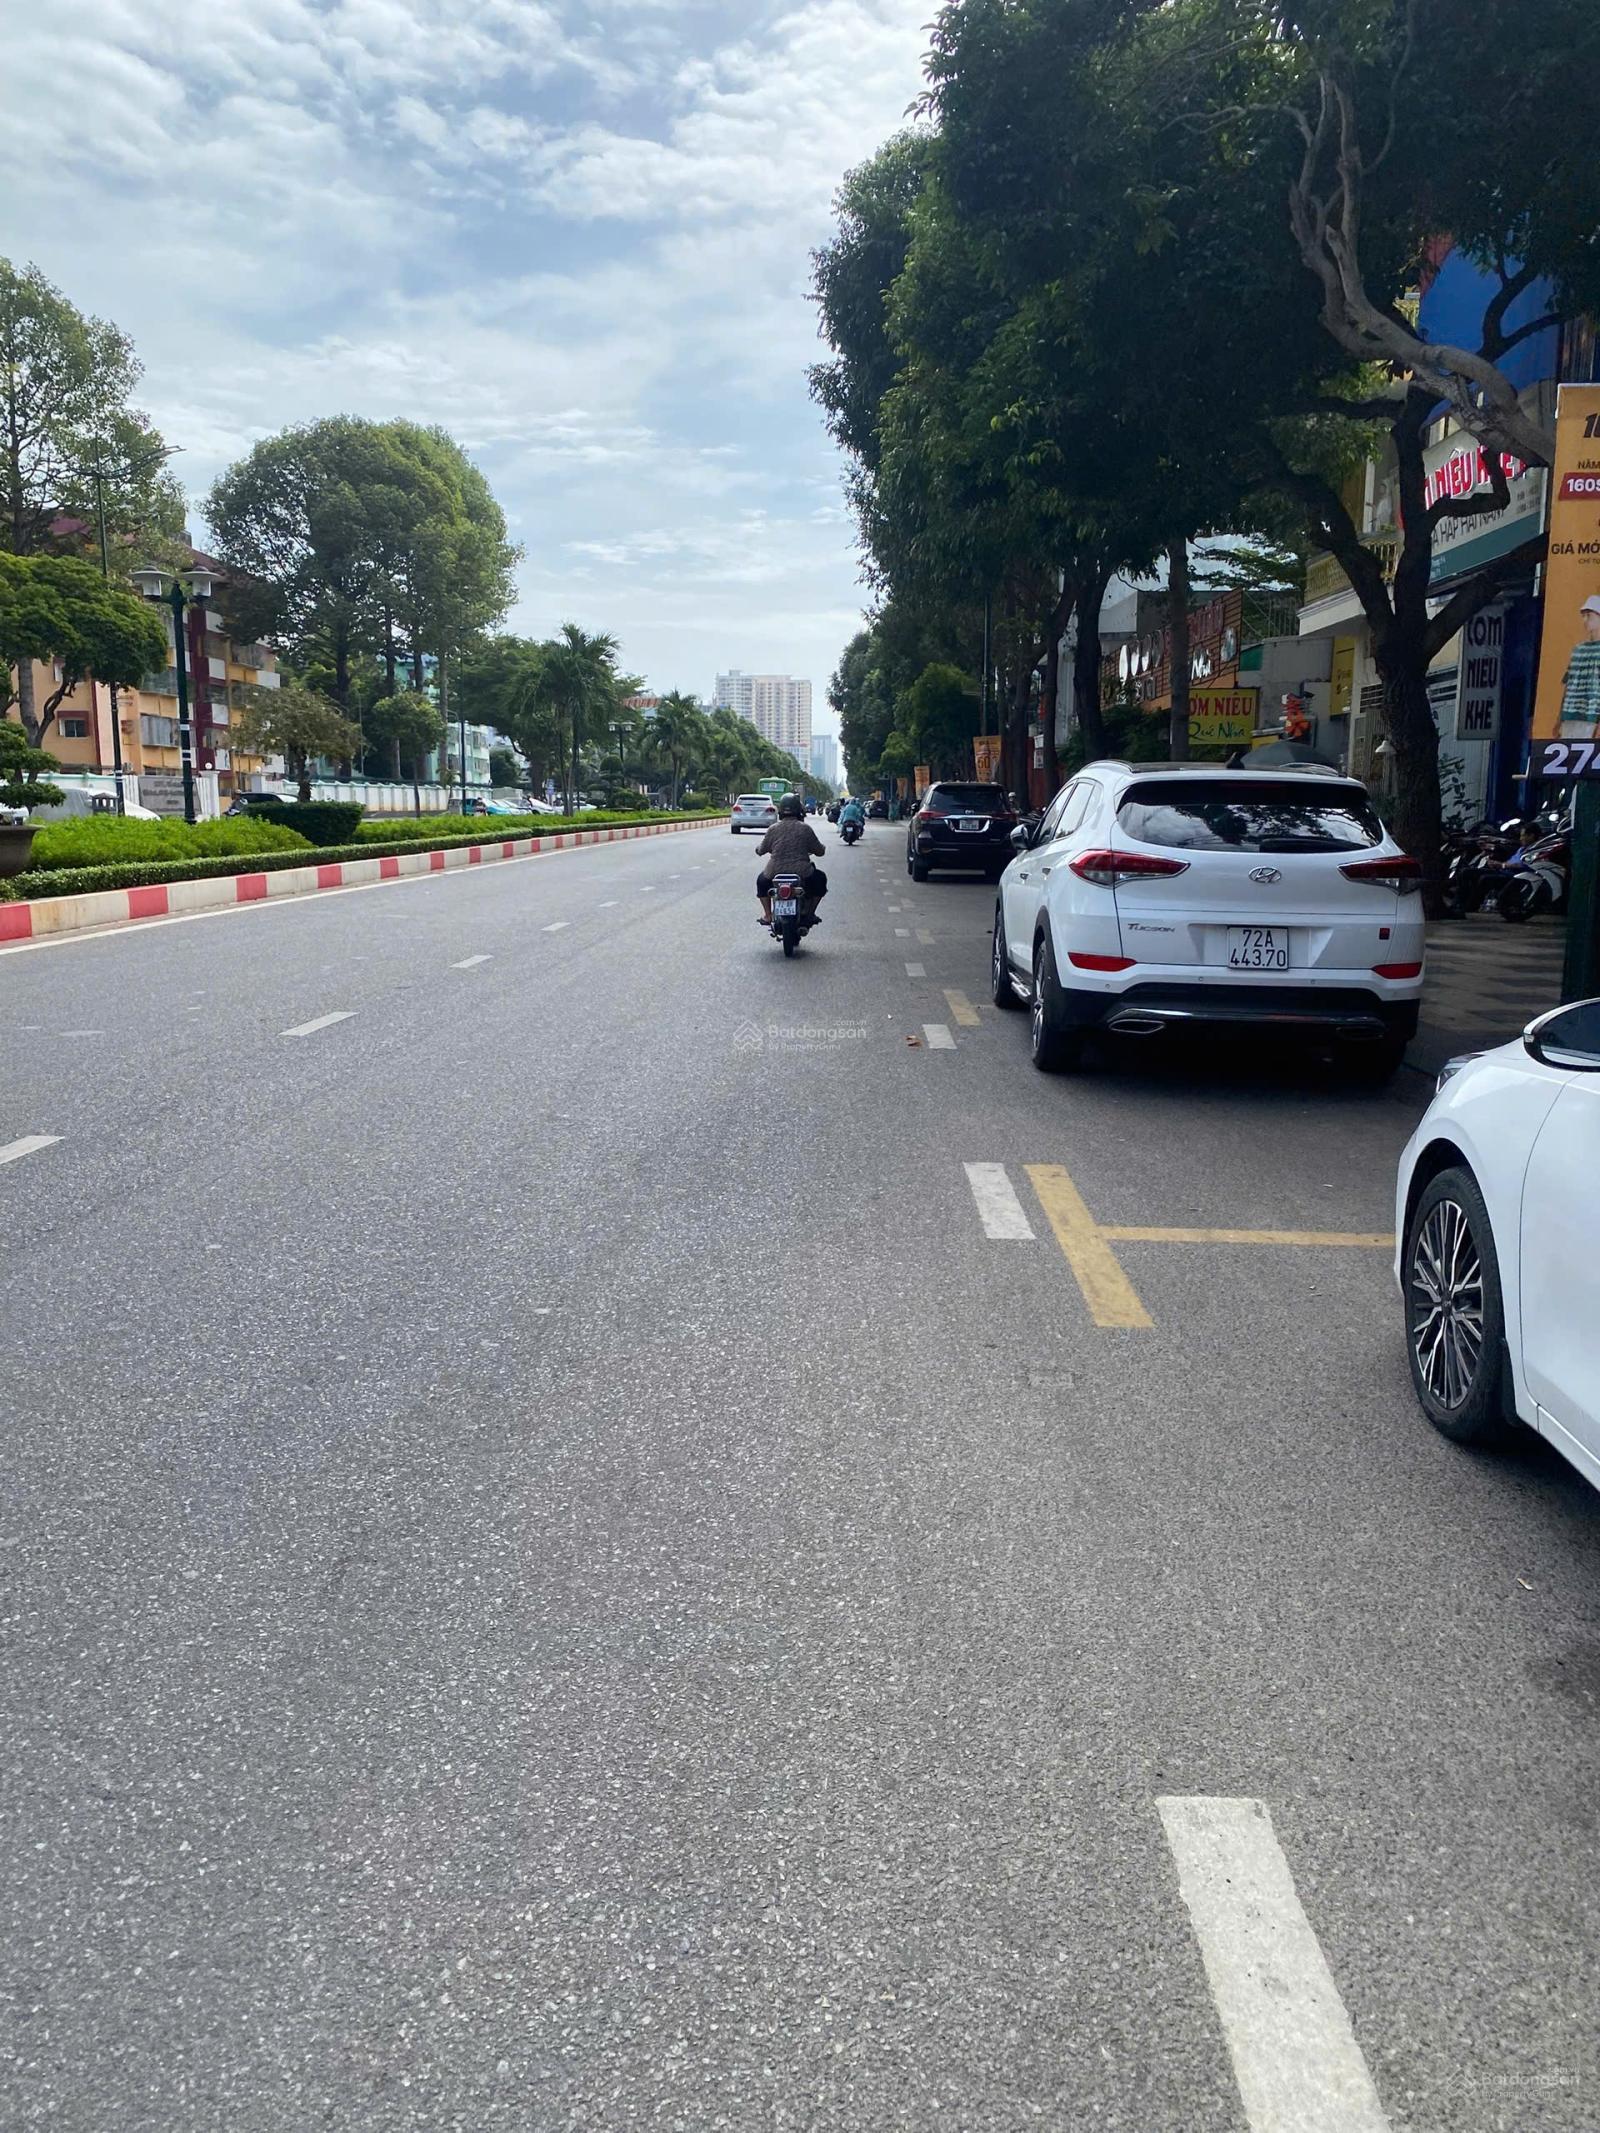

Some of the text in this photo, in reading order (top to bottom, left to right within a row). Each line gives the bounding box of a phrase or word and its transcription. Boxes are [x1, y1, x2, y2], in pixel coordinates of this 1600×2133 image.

[1551, 540, 1600, 555] GIÁ MỚ
[1189, 692, 1209, 716] ƠM
[1242, 929, 1274, 948] 72A
[1230, 948, 1287, 967] 443.70
